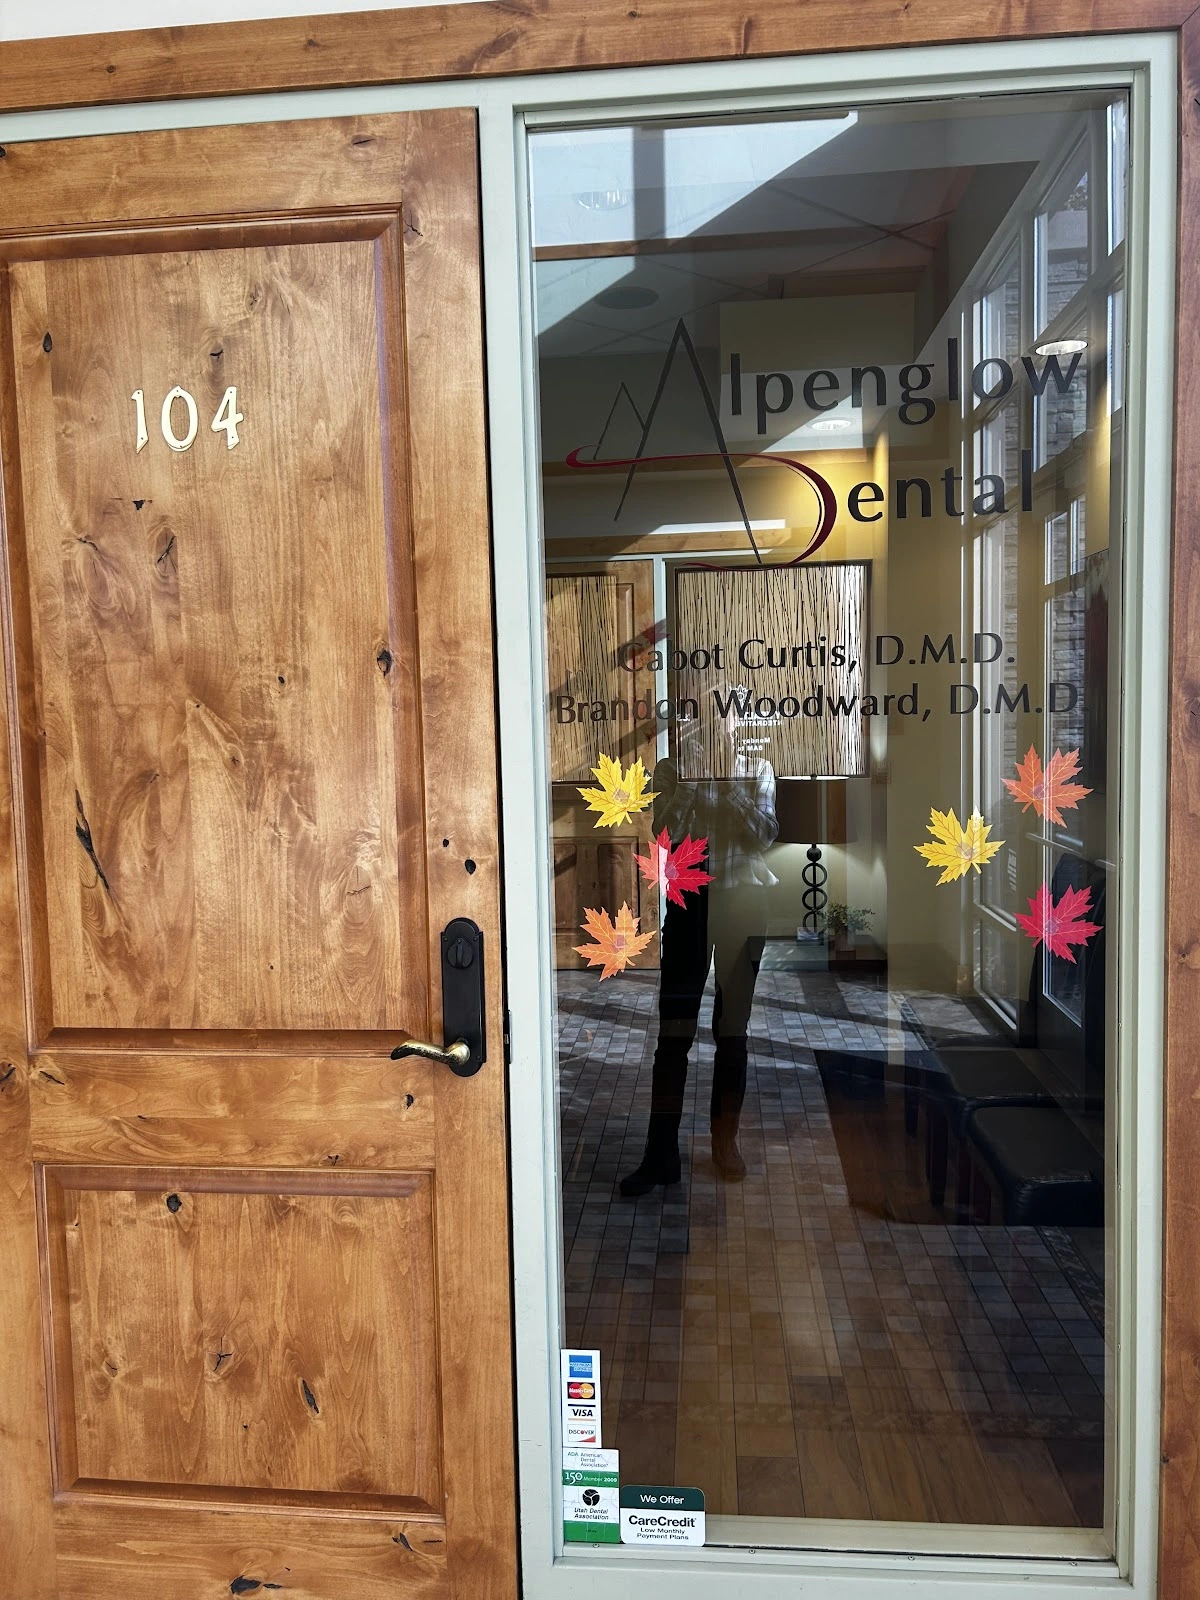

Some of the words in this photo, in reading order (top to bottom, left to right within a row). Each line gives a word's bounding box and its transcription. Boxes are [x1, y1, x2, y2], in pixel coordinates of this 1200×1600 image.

[131, 385, 245, 455] 104
[618, 639, 725, 672] Cabot
[739, 636, 858, 675] Curtis,
[876, 632, 1015, 666] D.M.D.
[556, 689, 699, 724] Brandon
[713, 682, 931, 722] Woodward,
[572, 1409, 593, 1417] VISA
[565, 1472, 583, 1485] 150
[640, 1494, 657, 1504] We
[659, 1495, 684, 1504] Offer
[628, 1514, 696, 1528] CareCredit
